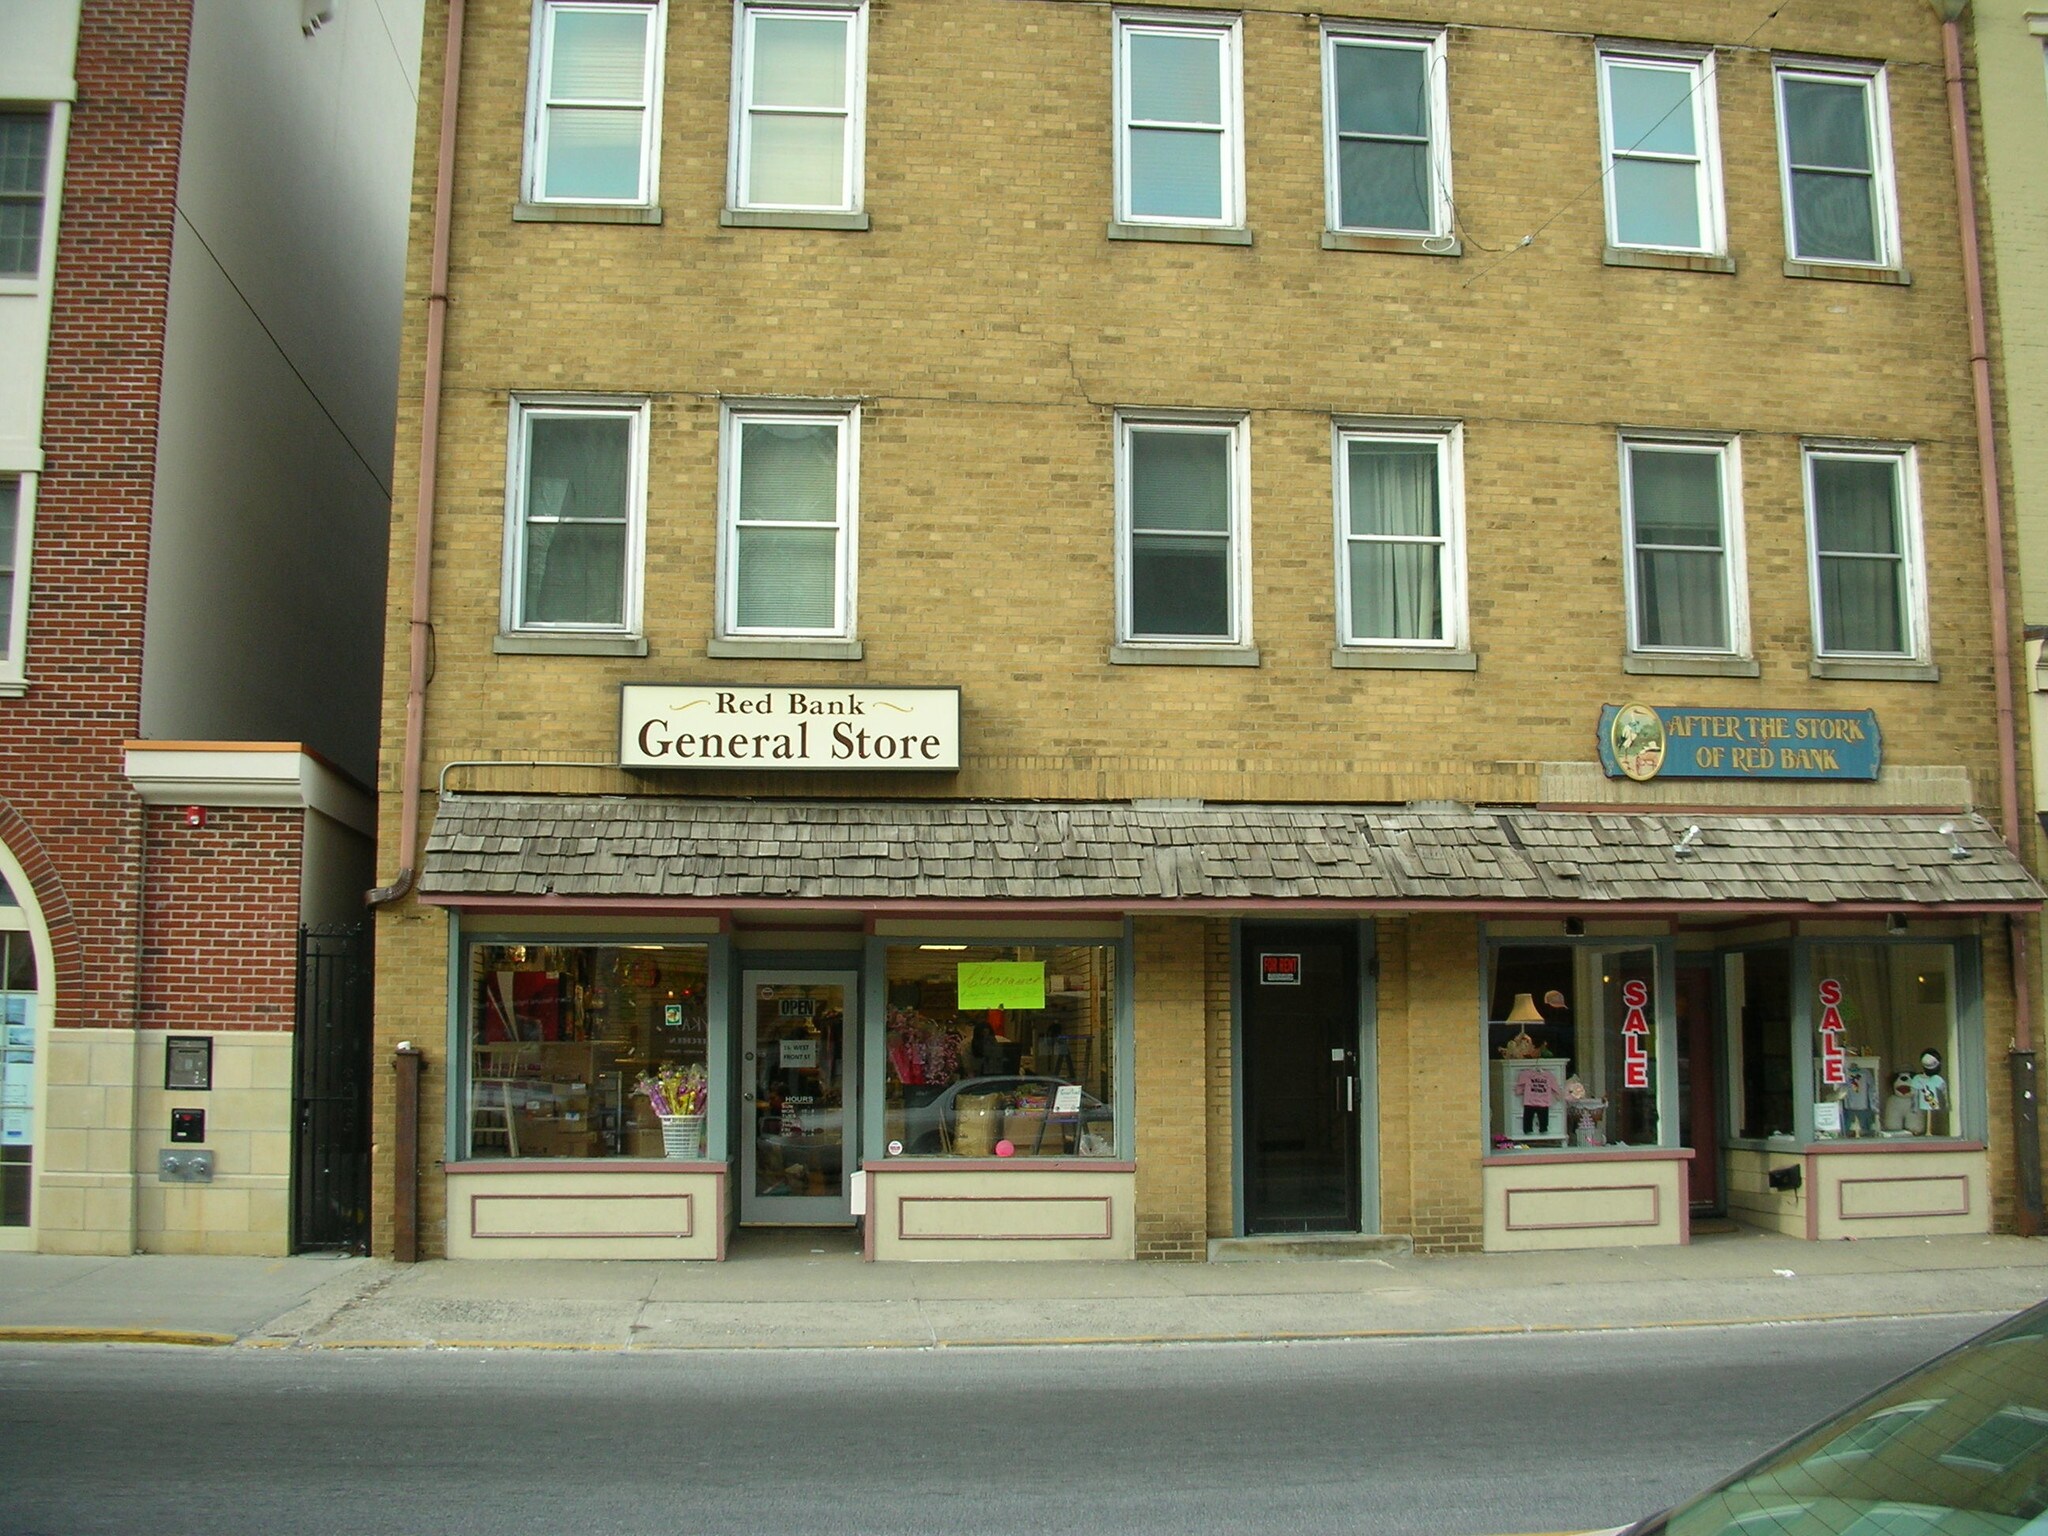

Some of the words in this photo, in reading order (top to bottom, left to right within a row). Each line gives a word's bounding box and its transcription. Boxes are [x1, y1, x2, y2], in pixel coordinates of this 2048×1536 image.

[715, 692, 773, 714] Red
[788, 693, 865, 715] Bank
[638, 719, 810, 759] General
[831, 721, 940, 760] Store
[1668, 714, 1745, 742] AFTER
[1745, 716, 1791, 743] THE
[1795, 718, 1866, 744] STORK
[1696, 747, 1725, 769] OF
[1732, 746, 1775, 772] RED
[1781, 748, 1840, 773] BANK
[1263, 957, 1278, 973] FOR
[1279, 957, 1297, 973] RENT
[781, 1000, 814, 1015] OPEN
[1621, 980, 1650, 1088] SALE
[1818, 979, 1846, 1084] SALE
